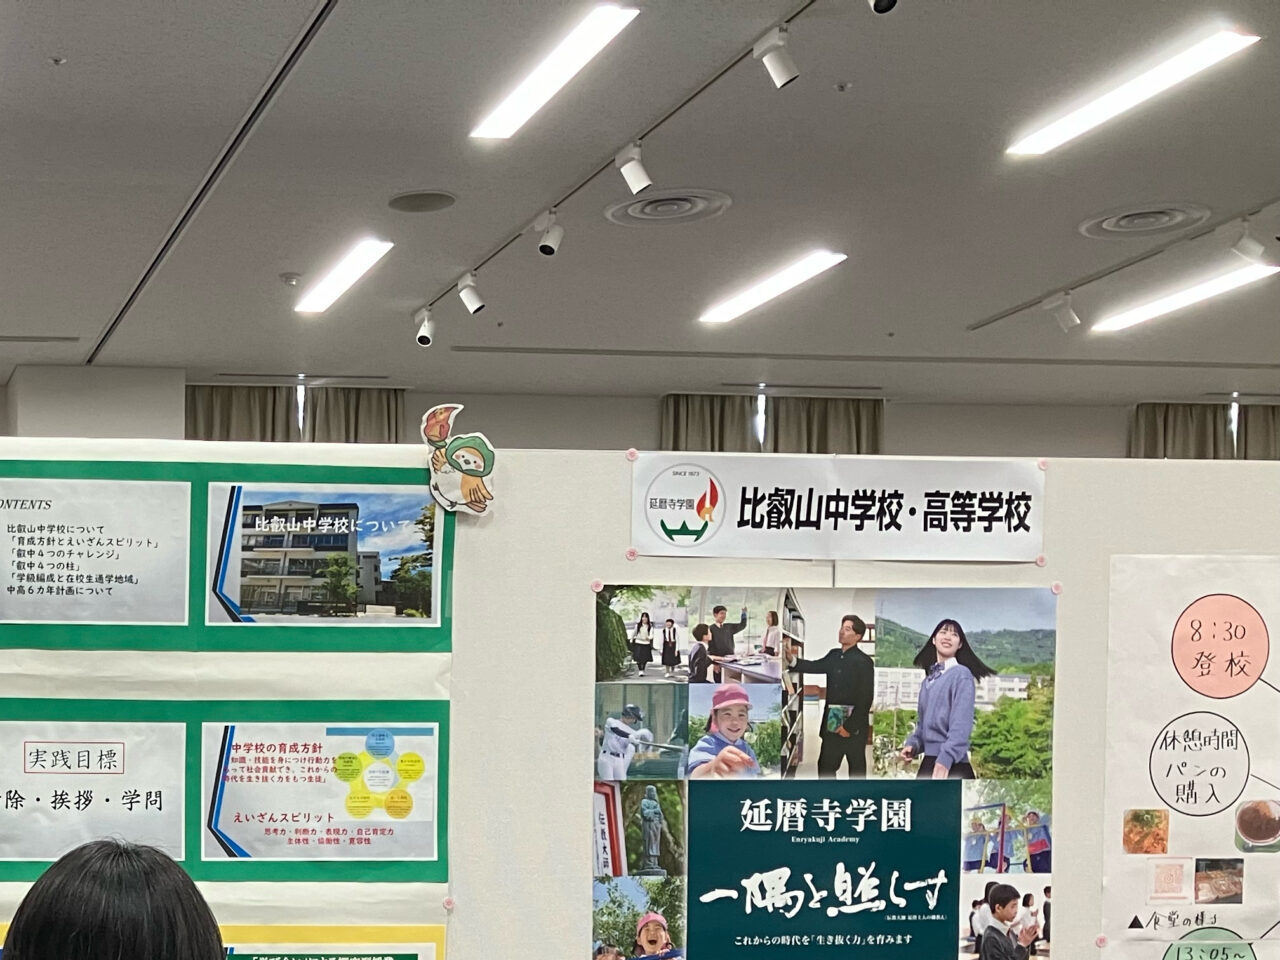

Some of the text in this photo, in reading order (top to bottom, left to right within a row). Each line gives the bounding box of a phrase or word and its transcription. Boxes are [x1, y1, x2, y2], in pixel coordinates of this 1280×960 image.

[736, 486, 1032, 533] 比叡山中学校・高等学校
[254, 515, 410, 534] 比叡山中学校について
[1189, 618, 1247, 643] 8:30
[1190, 650, 1252, 679] 登校
[1159, 728, 1239, 752] 休憩時間
[28, 748, 117, 770] 実践目標
[1166, 761, 1226, 779] パンの
[1175, 780, 1221, 804] 購入
[233, 812, 335, 824] えいざんスピリット
[739, 798, 912, 832] 延暦寺学園
[791, 835, 860, 844] Enryakuji Academy
